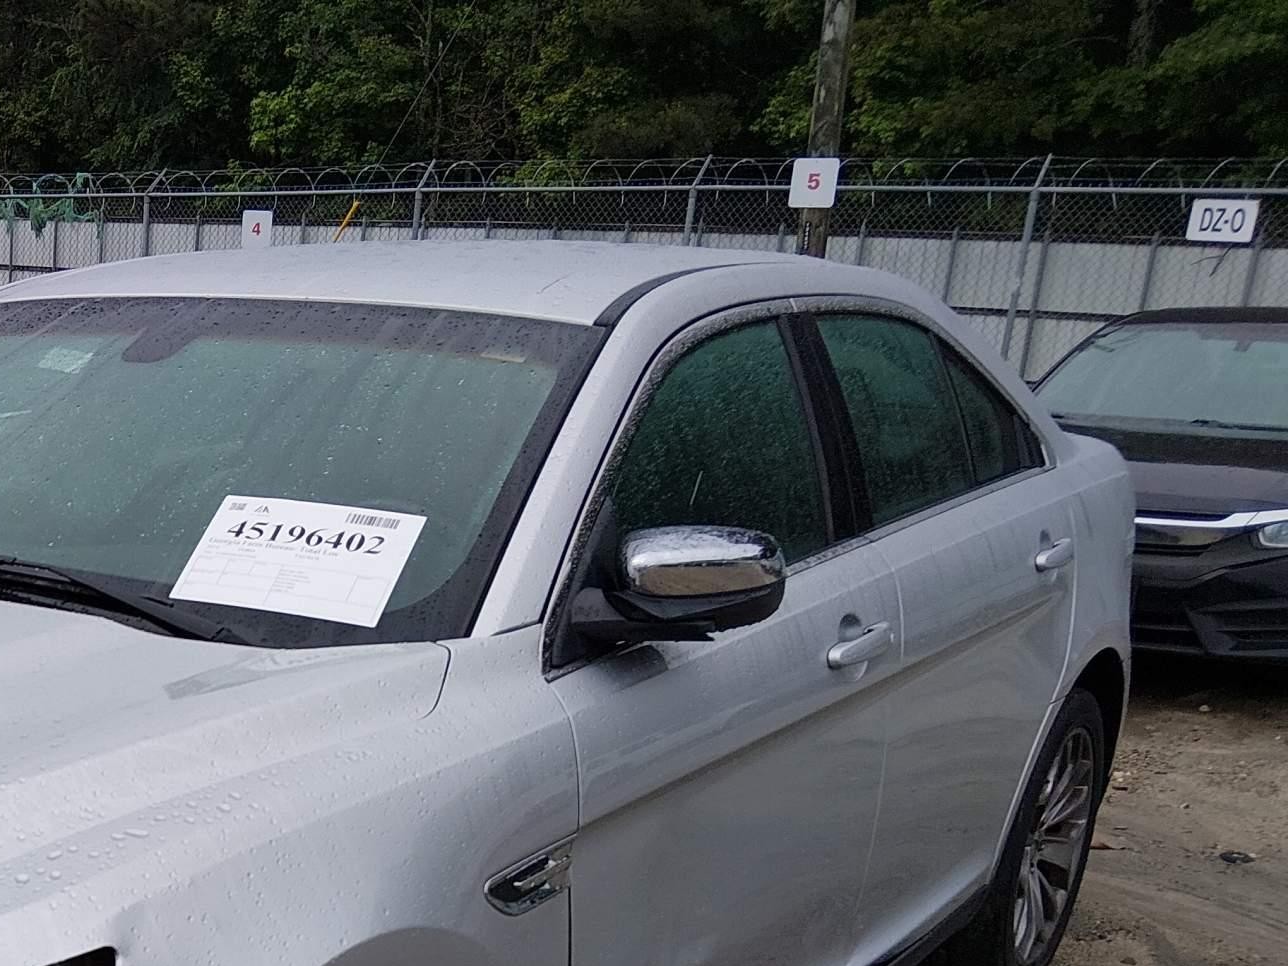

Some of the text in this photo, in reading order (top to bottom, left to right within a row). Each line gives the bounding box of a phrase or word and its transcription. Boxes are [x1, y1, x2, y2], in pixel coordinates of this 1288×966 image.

[807, 172, 821, 191] 5
[251, 221, 261, 236] 4
[226, 519, 386, 555] 45196402
